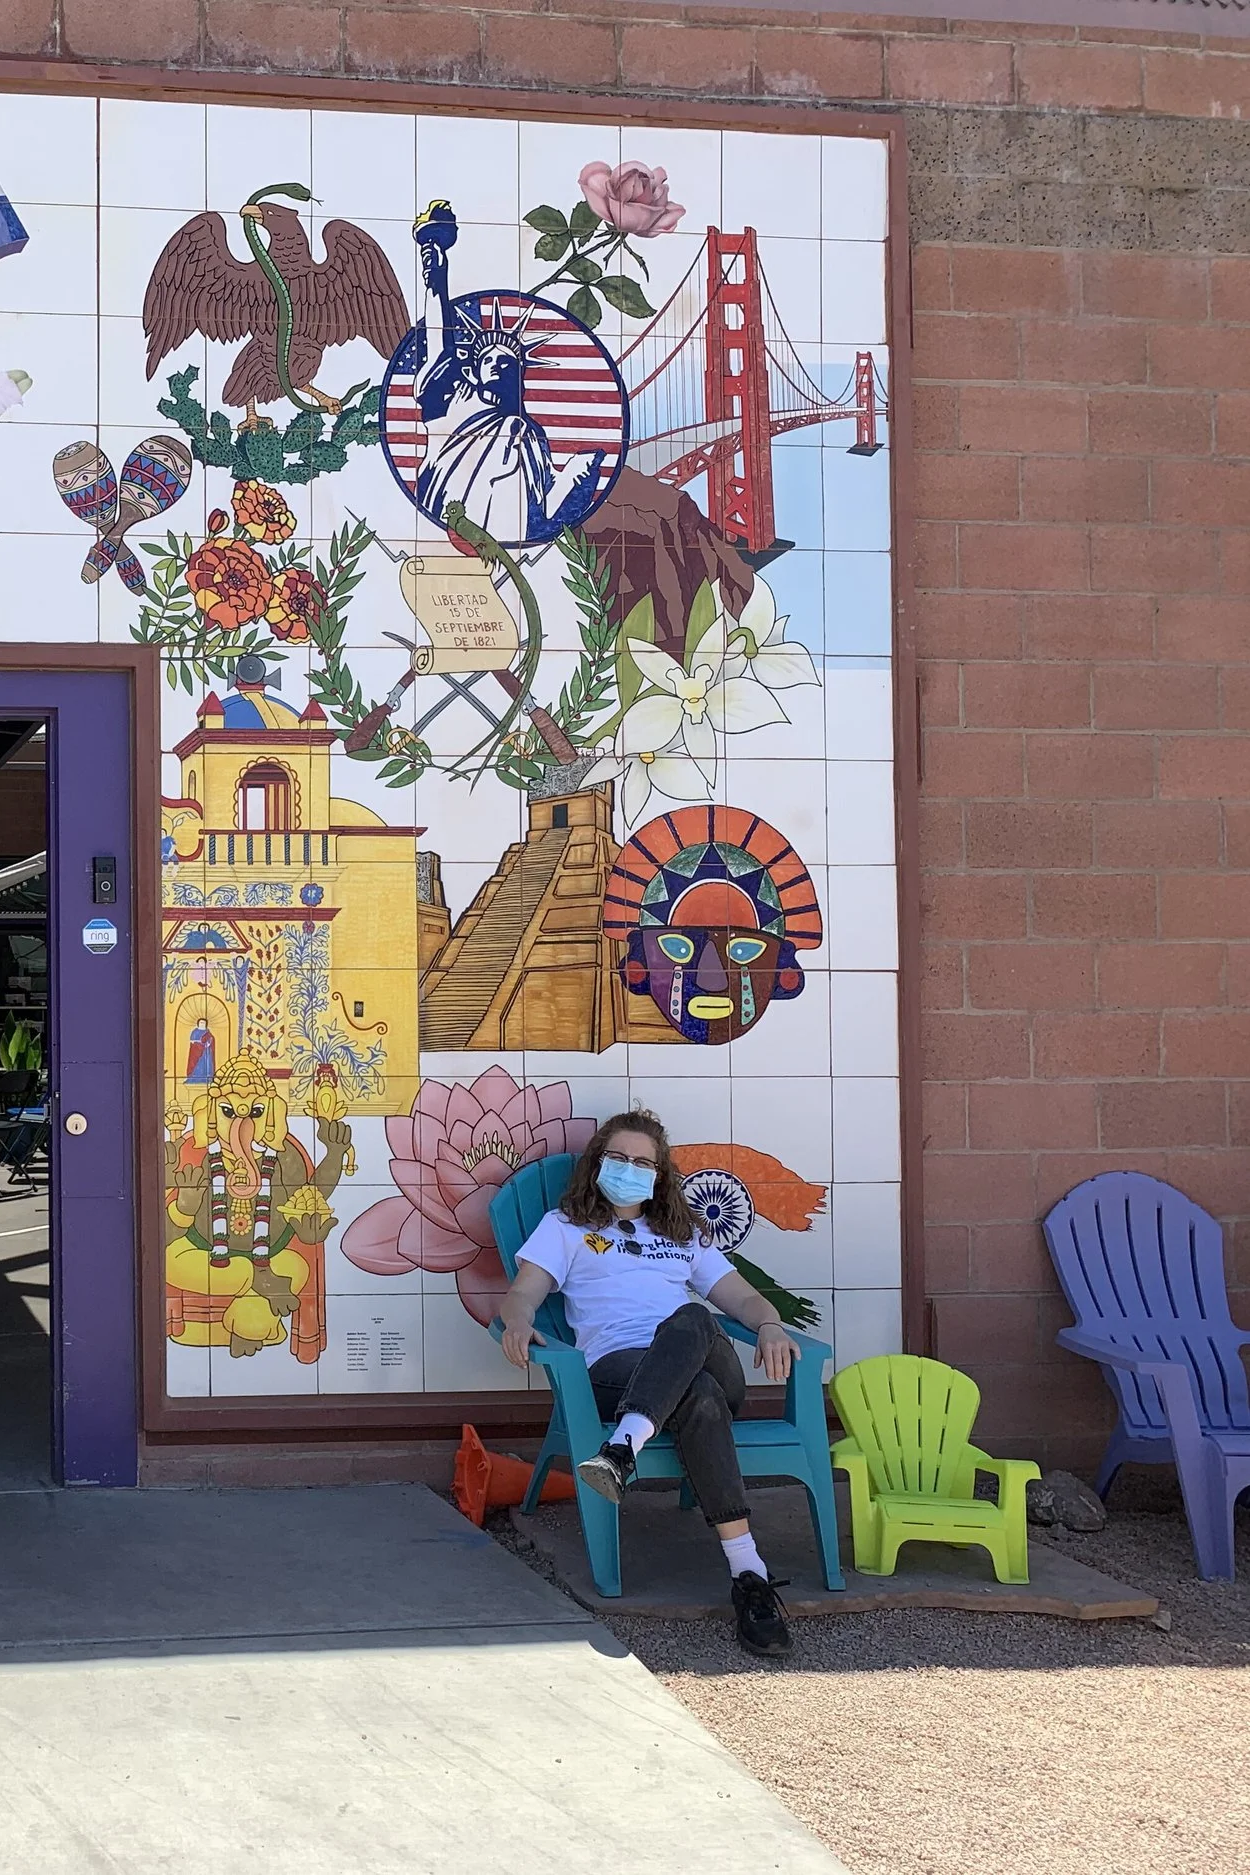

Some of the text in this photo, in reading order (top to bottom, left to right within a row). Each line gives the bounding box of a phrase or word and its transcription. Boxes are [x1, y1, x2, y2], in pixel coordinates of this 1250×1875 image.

[432, 594, 488, 606] LIBERTAD
[449, 608, 481, 618] 15 DE
[435, 621, 505, 633] SEPTIEMBRE
[454, 637, 496, 647] DE 1821
[90, 931, 110, 943] ring
